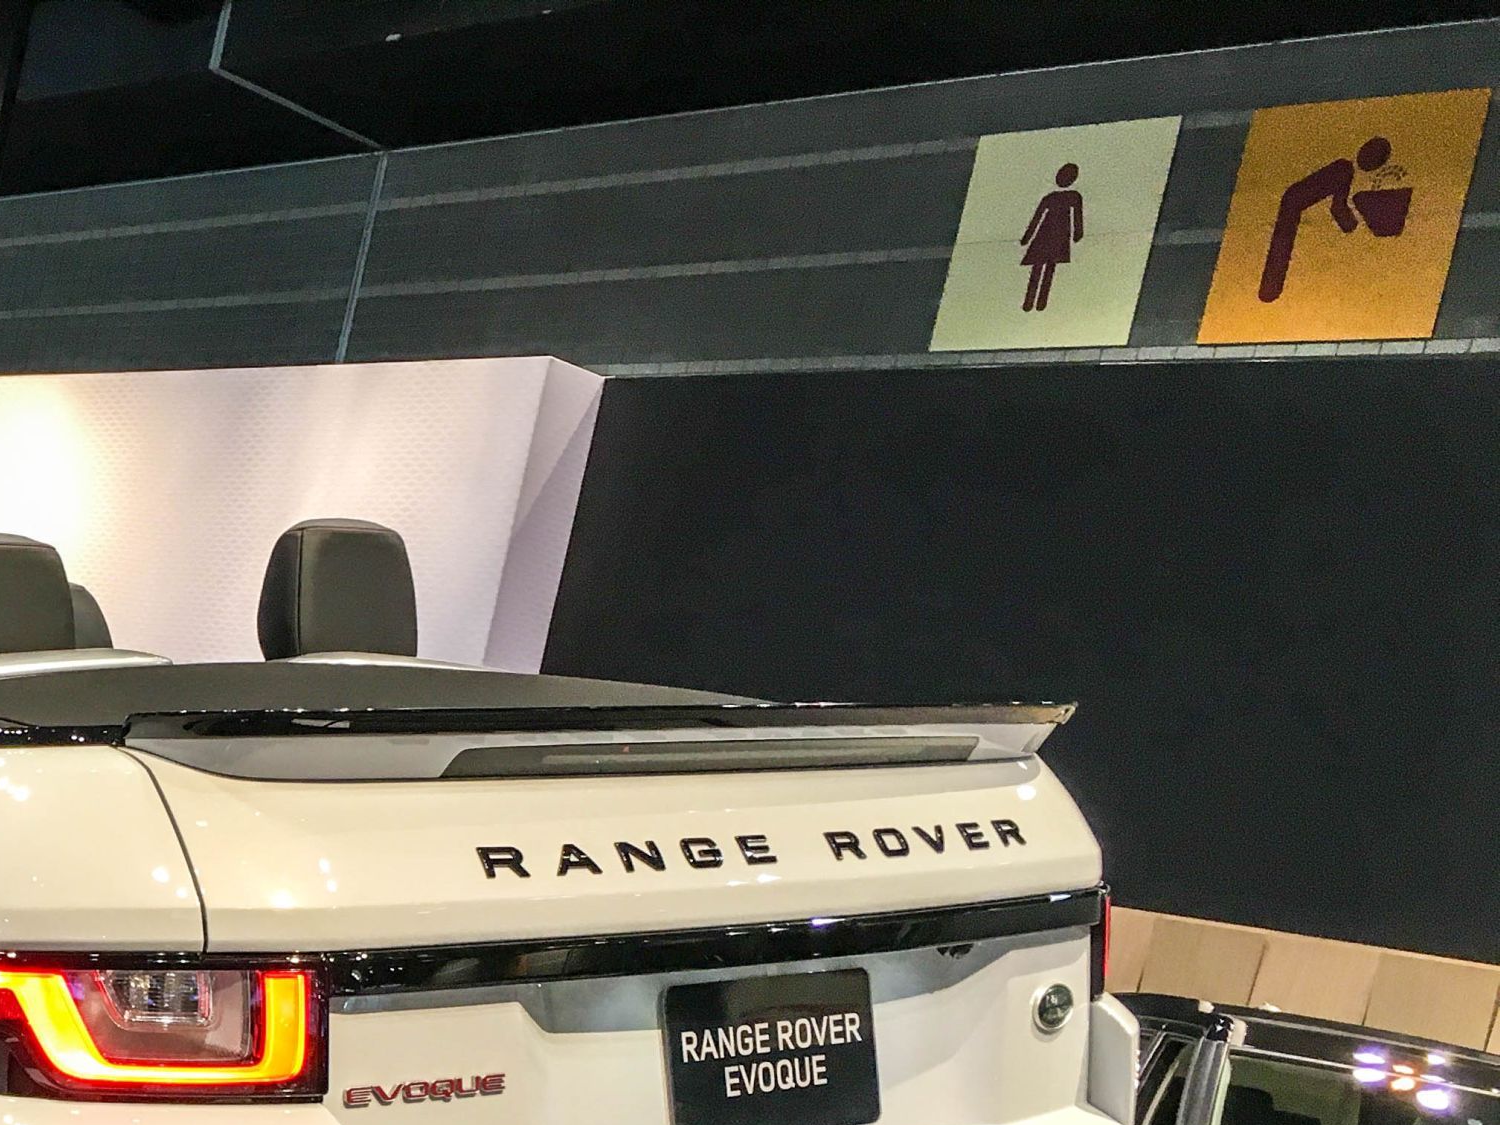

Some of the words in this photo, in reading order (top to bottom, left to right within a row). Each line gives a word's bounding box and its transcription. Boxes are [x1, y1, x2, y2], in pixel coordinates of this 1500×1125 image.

[475, 834, 779, 880] RANGE
[823, 818, 1028, 862] ROVER
[681, 1022, 771, 1063] RANGE
[776, 1012, 863, 1051] ROVER
[344, 1073, 506, 1107] EVOQUE
[724, 1054, 828, 1098] EVOQUE
